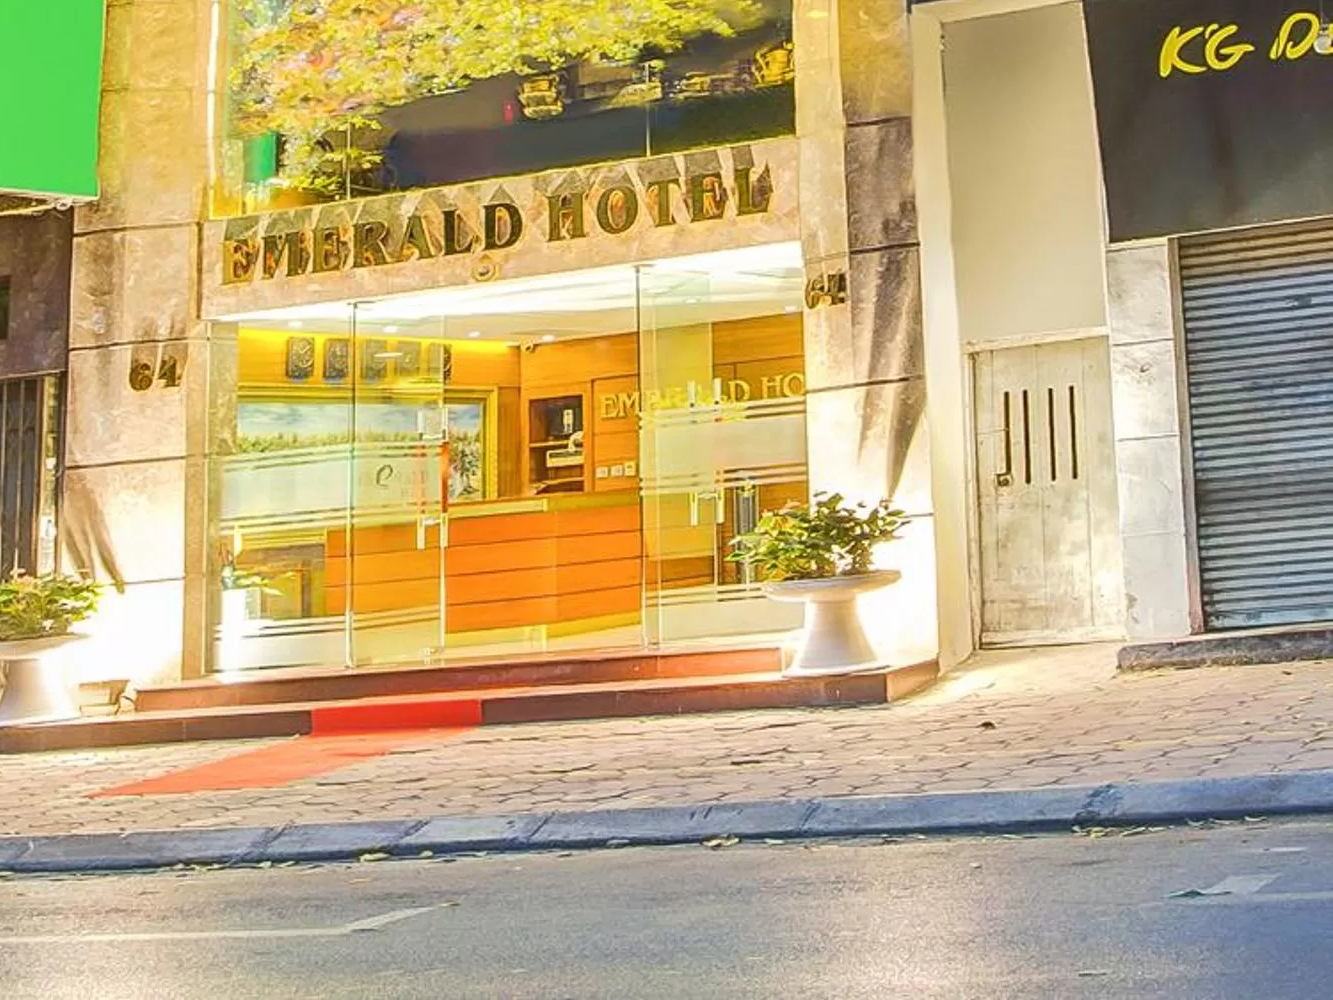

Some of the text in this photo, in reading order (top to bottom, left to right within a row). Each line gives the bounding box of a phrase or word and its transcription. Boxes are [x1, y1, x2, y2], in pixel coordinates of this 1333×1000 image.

[221, 163, 774, 286] EMERALD HOTEL
[128, 355, 181, 392] 64
